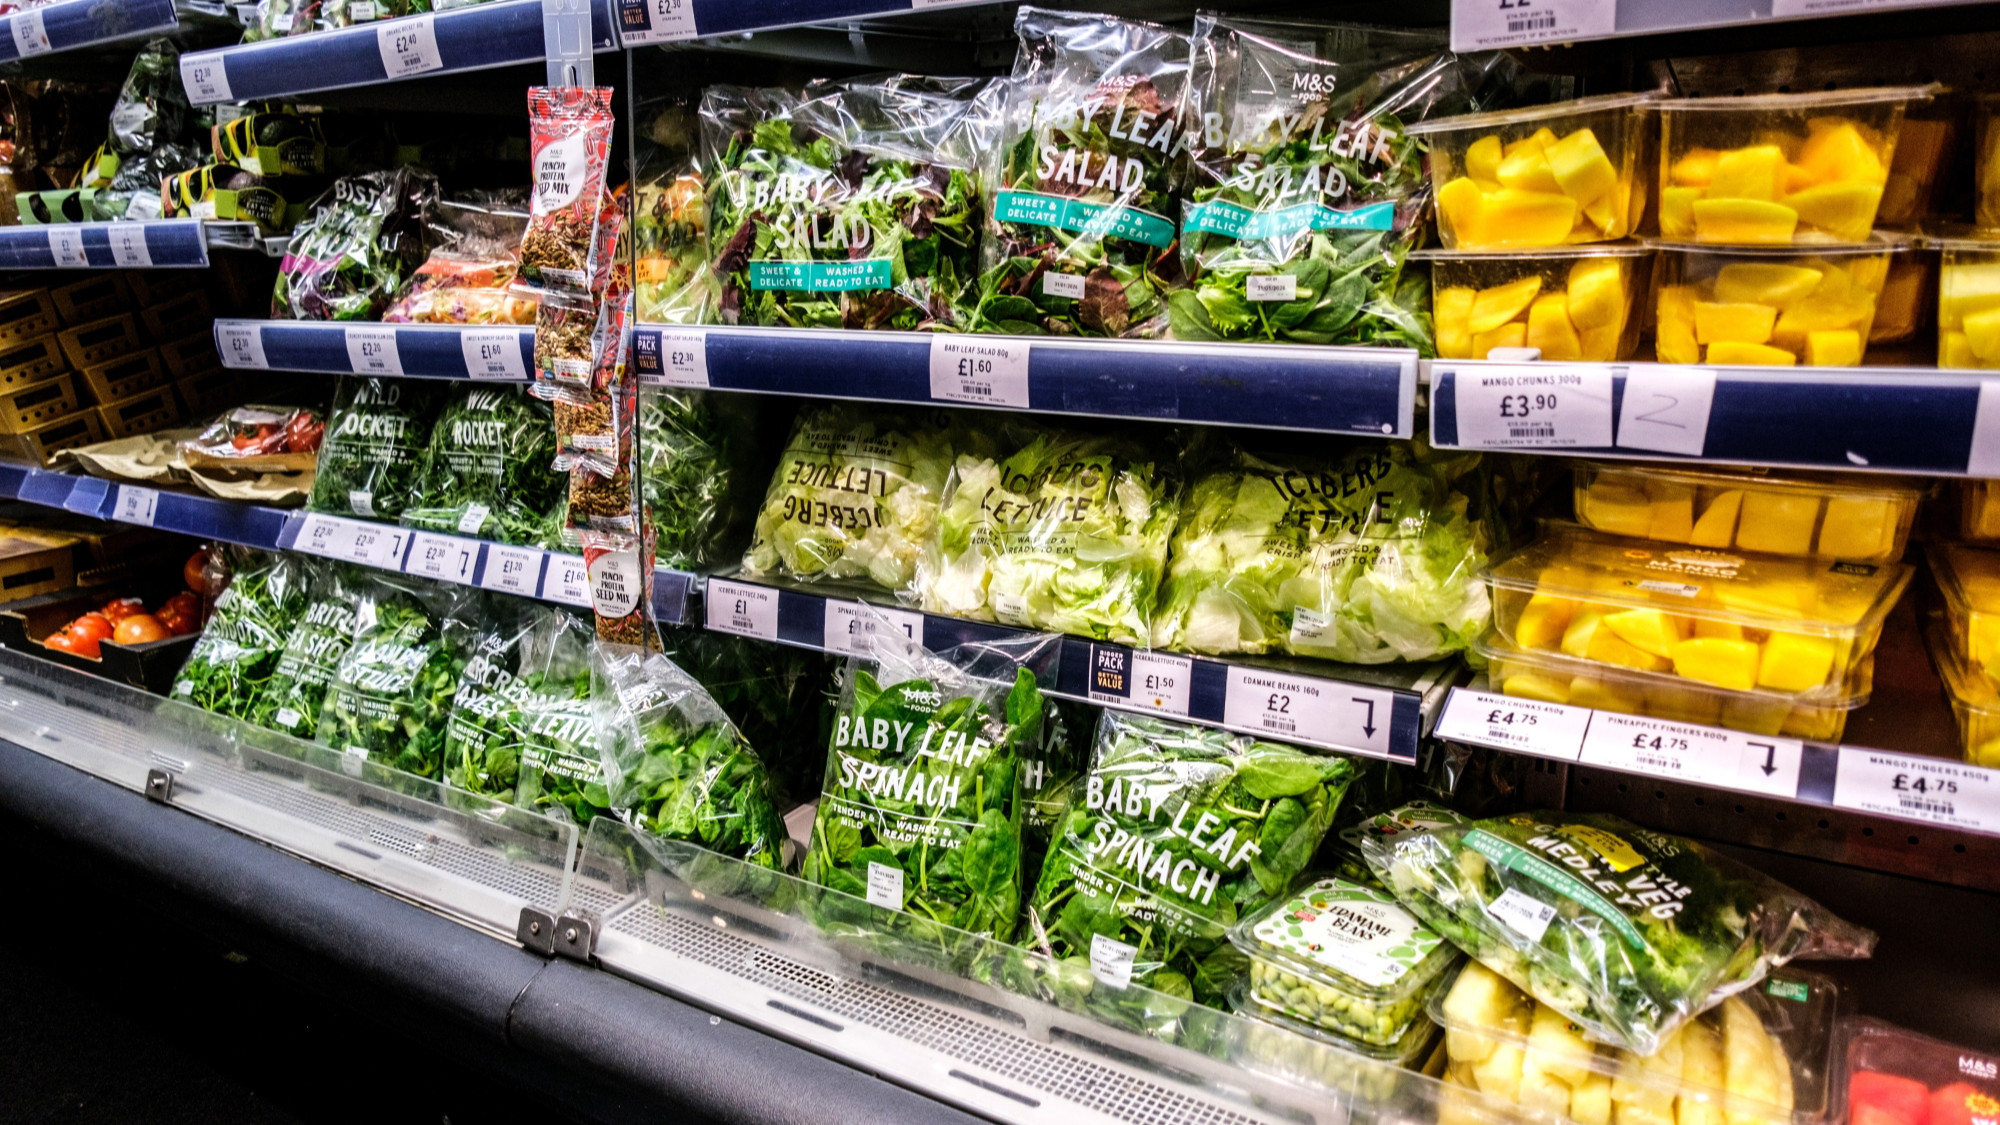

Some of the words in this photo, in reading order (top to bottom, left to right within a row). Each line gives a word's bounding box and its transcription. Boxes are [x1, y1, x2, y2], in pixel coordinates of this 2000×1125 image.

[624, 15, 644, 24] VALUE
[396, 33, 417, 53] £2.40
[1099, 74, 1137, 87] M&S
[1292, 72, 1336, 93] M&S
[1298, 93, 1322, 101] FOOD
[1309, 117, 1397, 165] LEAF
[542, 161, 566, 171] PUNCHY
[1036, 145, 1144, 194] SALAD
[540, 172, 566, 181] PROTEIN
[1235, 161, 1347, 198] SALAD
[552, 181, 570, 195] MIX
[754, 172, 833, 209] BABY
[1011, 197, 1046, 208] SWEET
[1049, 202, 1057, 211] &
[1007, 208, 1056, 223] DELICATE
[1205, 206, 1246, 221] SWEET
[774, 214, 871, 249] SALAD
[1129, 228, 1150, 239] EAT
[1200, 217, 1260, 236] DELICATE
[760, 266, 790, 276] SWEET
[793, 267, 801, 276] &
[825, 265, 865, 276] WASHED
[867, 264, 874, 273] &
[760, 277, 803, 287] DELICATE
[815, 278, 849, 288] READY
[850, 277, 862, 286] TO
[865, 276, 885, 285] EAT
[481, 344, 501, 359] £1.60
[638, 340, 656, 351] PACK
[944, 344, 959, 352] BABY
[961, 346, 975, 354] LEAF
[976, 346, 996, 356] SALAD
[997, 349, 1009, 358] 80g
[640, 360, 658, 369] VALUE
[672, 351, 694, 365] £2.30
[958, 358, 992, 377] £1.60
[1481, 377, 1515, 387] MANGO
[1516, 376, 1555, 386] CHUNKS
[1558, 375, 1582, 385] 300g
[1499, 394, 1557, 417] £3.90
[1634, 393, 1687, 429] 2
[454, 421, 506, 446] ROCKET
[787, 460, 887, 498] LETTUCE
[1000, 461, 1104, 495] ICEBERG
[783, 495, 882, 530] ICEBERG
[980, 486, 1093, 525] LETTUCE
[426, 547, 445, 560] £2.30
[1056, 546, 1075, 555] EAT
[1266, 548, 1301, 560] CRISP
[503, 560, 522, 573] £1.20
[1352, 556, 1366, 565] TO
[1372, 556, 1395, 566] EAT
[1649, 560, 1738, 577] MANGO
[564, 569, 586, 584] £1.60
[601, 571, 624, 582] PUNCHY
[601, 580, 625, 592] PROTEIN
[718, 586, 737, 596] ICEBERG
[737, 590, 756, 598] LETTUCE
[756, 592, 768, 602] 240g
[596, 589, 614, 601] SEED
[616, 593, 630, 604] MIX
[735, 599, 747, 615] £1
[205, 614, 265, 646] SHOOTS
[1098, 656, 1123, 670] PACK
[1134, 654, 1154, 662] ICEBERG
[1153, 657, 1175, 665] LETTUCE
[1098, 677, 1122, 690] VALUE
[1146, 675, 1174, 689] £1.50
[1243, 676, 1276, 689] EDAMAME
[1277, 681, 1300, 692] BEANS
[1303, 685, 1320, 697] 160g
[363, 700, 388, 711] WASHED
[904, 687, 941, 707] M&S
[1267, 693, 1290, 714] £2
[910, 705, 931, 713] FOOD
[1477, 696, 1506, 706] MANGO
[1508, 700, 1541, 711] CHUNKS
[1544, 706, 1564, 716] 450g
[378, 711, 386, 719] TO
[387, 713, 400, 721] EAT
[1486, 709, 1538, 726] £4.75
[455, 724, 478, 738] WASHED
[1608, 717, 1658, 731] PINEAPPLE
[1660, 724, 1701, 737] FINGERS
[1703, 731, 1728, 742] 600g
[474, 740, 486, 751] EAT
[836, 715, 913, 753] BABY
[919, 727, 990, 768] LEAF
[1632, 733, 1688, 751] £4.75
[558, 757, 588, 770] WASHED
[1870, 756, 1908, 769] MANGO
[1911, 763, 1959, 776] FINGERS
[1961, 770, 1990, 782] 450g
[549, 765, 571, 777] READY
[573, 771, 583, 780] TO
[838, 757, 960, 808] SPINACH
[1891, 773, 1958, 794] £4.75
[833, 803, 867, 820] TENDER
[868, 812, 875, 822] &
[840, 817, 864, 830] MILD
[896, 819, 939, 836] WASHED
[943, 827, 952, 836] &
[1087, 776, 1169, 823] BABY
[1171, 801, 1262, 870] LEAF
[883, 828, 918, 844] READY
[921, 835, 935, 846] TO
[940, 838, 961, 849] EAT
[1475, 832, 1505, 848] SWEET
[1635, 829, 1680, 857] M&S
[1473, 840, 1504, 859] GREEN
[1089, 823, 1220, 906] SPINACH
[1523, 855, 1572, 885] PREPARED
[1526, 835, 1643, 907] MEDLEY
[1070, 863, 1104, 889] TENDER
[1105, 883, 1114, 894] &
[1522, 864, 1555, 884] STEAM
[1556, 882, 1571, 893] OR
[1074, 878, 1098, 898] MILD
[1626, 873, 1684, 920] VEG
[1119, 903, 1159, 924] READY
[1161, 917, 1174, 928] TO
[1177, 924, 1199, 940] EAT
[1185, 917, 1194, 927] &
[1329, 905, 1395, 936] EDAMAME
[1332, 917, 1376, 941] BEANS
[1958, 1056, 1998, 1076] M&S
